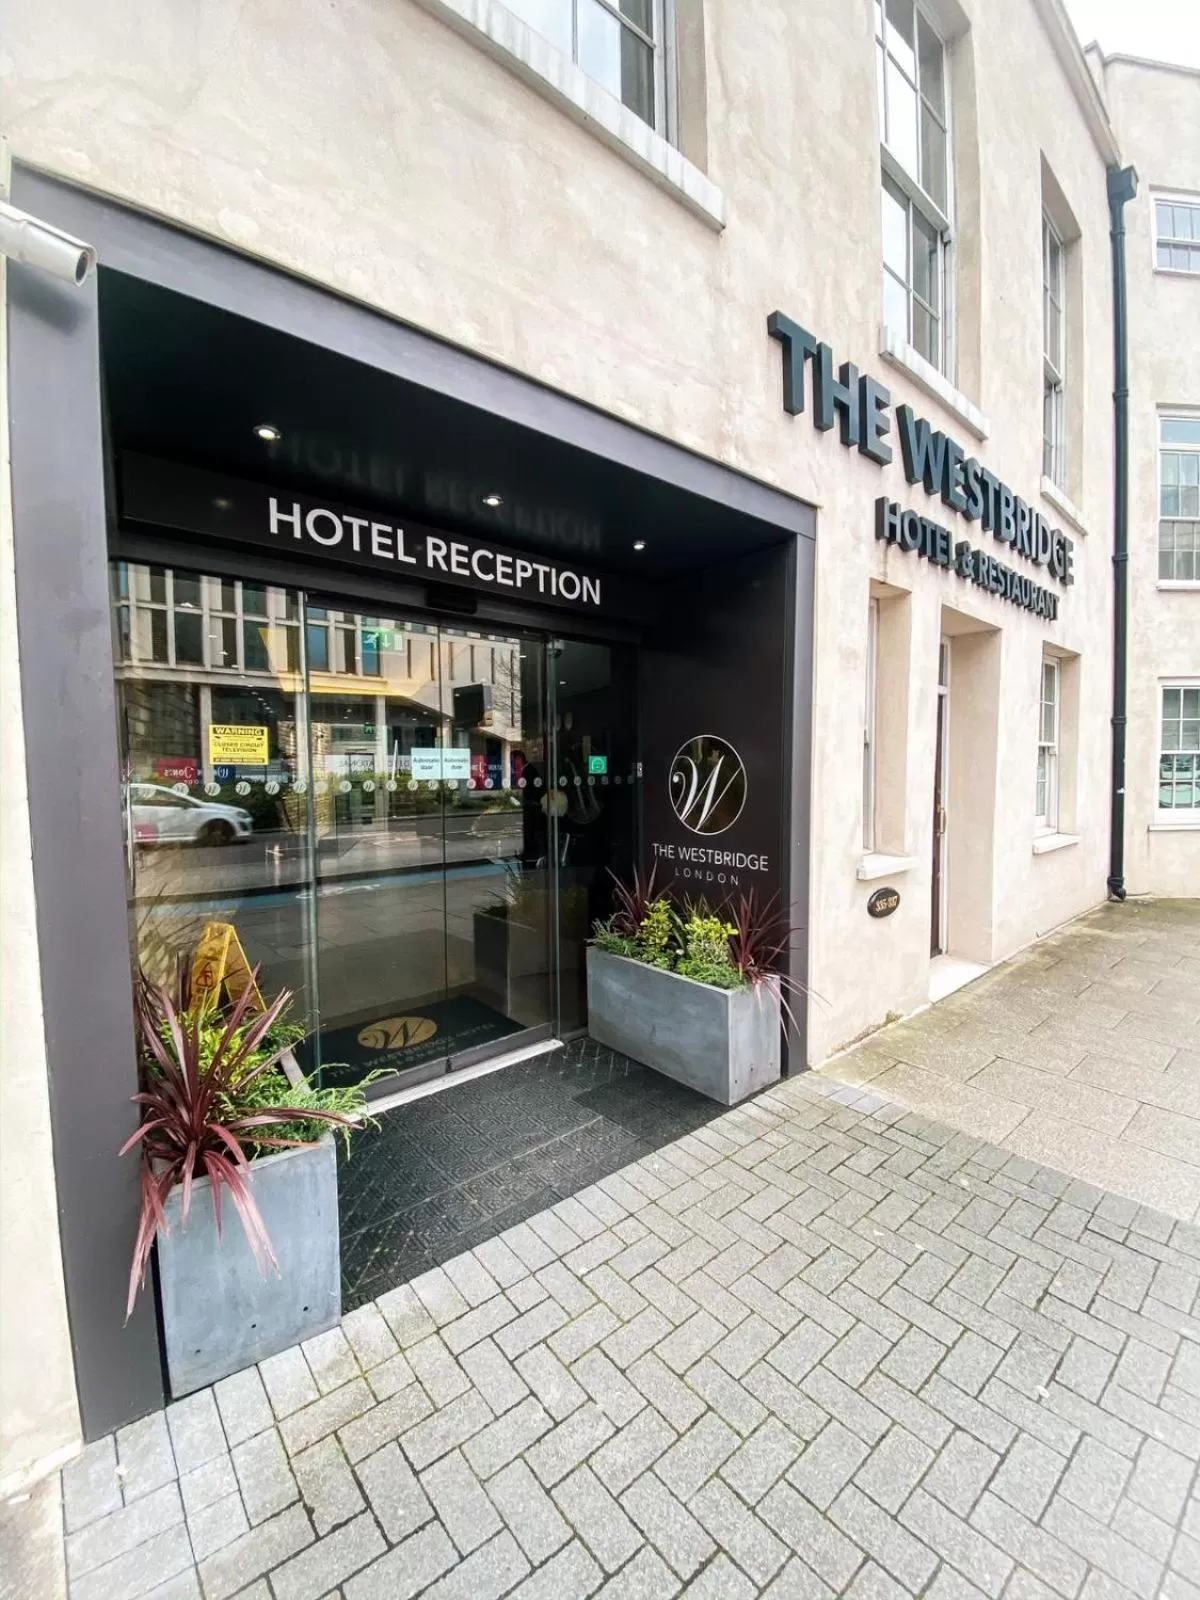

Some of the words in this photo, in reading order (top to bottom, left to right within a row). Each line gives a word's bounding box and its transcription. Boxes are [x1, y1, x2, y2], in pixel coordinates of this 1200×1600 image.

[767, 310, 892, 466] THE
[896, 403, 1074, 585] WESTBRIDGE
[268, 497, 416, 564] HOTEL
[427, 536, 601, 605] RECEPTION
[875, 496, 957, 571] HOTEL
[955, 540, 974, 579] &
[972, 549, 1060, 620] RESTAURANT
[214, 727, 263, 735] WARNING
[653, 843, 675, 859] THE
[678, 846, 769, 871] WESTBRIDGE
[674, 867, 739, 886] LONDON
